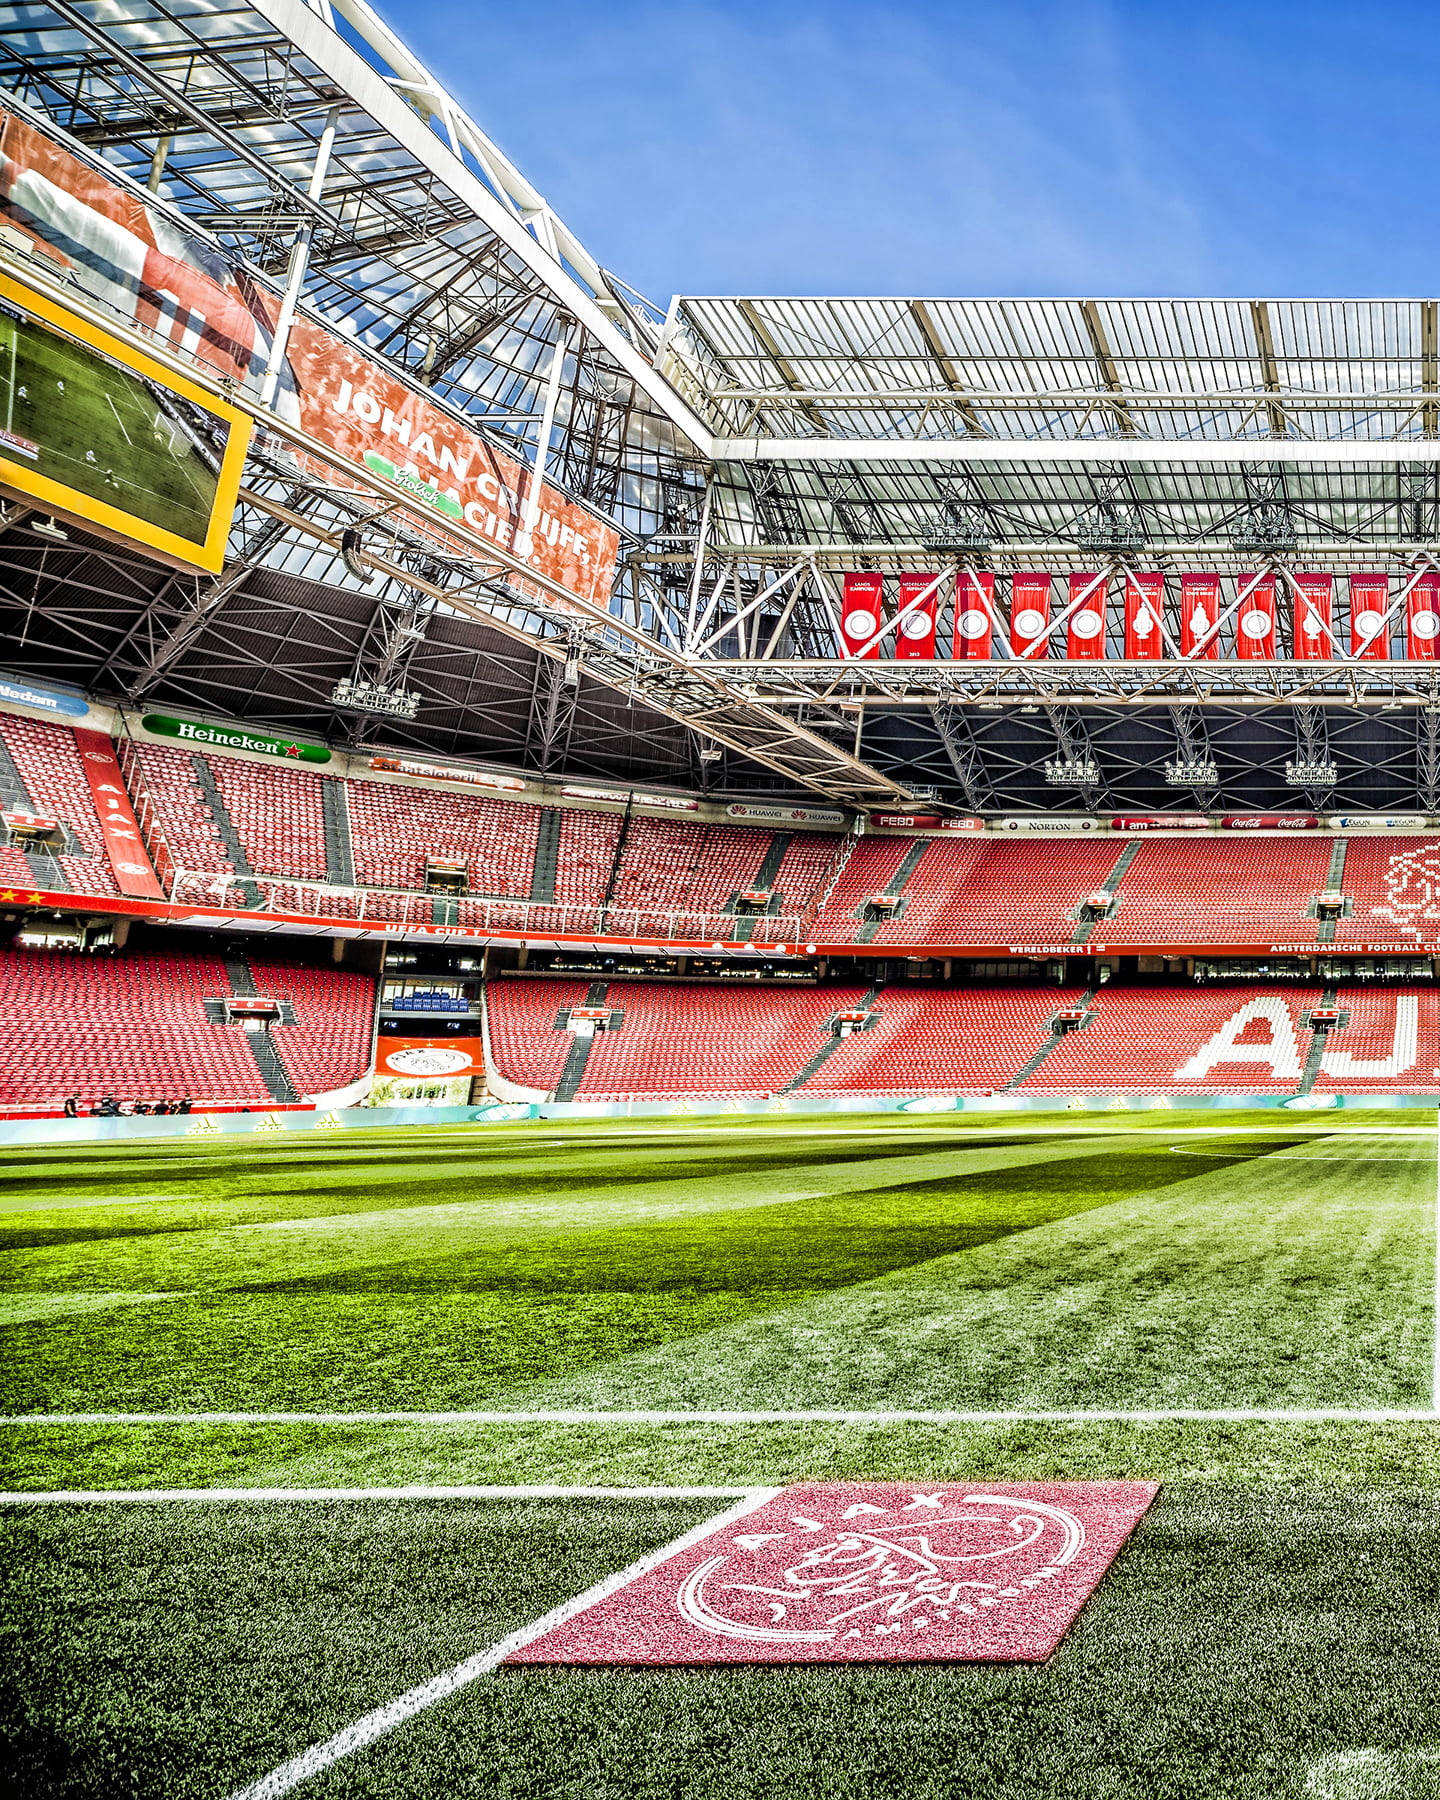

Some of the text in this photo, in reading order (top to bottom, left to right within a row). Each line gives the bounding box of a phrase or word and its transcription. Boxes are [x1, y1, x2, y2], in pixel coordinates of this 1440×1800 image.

[332, 378, 468, 482] JOHAN
[393, 465, 440, 505] Grolsch
[178, 723, 280, 754] Heineken
[382, 762, 476, 783] Staatsloterij
[749, 809, 841, 822] HUAWEI HUAWEI
[880, 816, 975, 829] FEBO FEBO
[1029, 822, 1071, 830] NORTON
[385, 924, 428, 934] UEFA
[435, 927, 467, 936] CUP
[1009, 945, 1083, 954] WERELDBEKER
[1270, 944, 1362, 952] AMSTERDAMSCHE
[1367, 944, 1421, 952] FOOTBALL
[734, 1491, 949, 1551] AJAX
